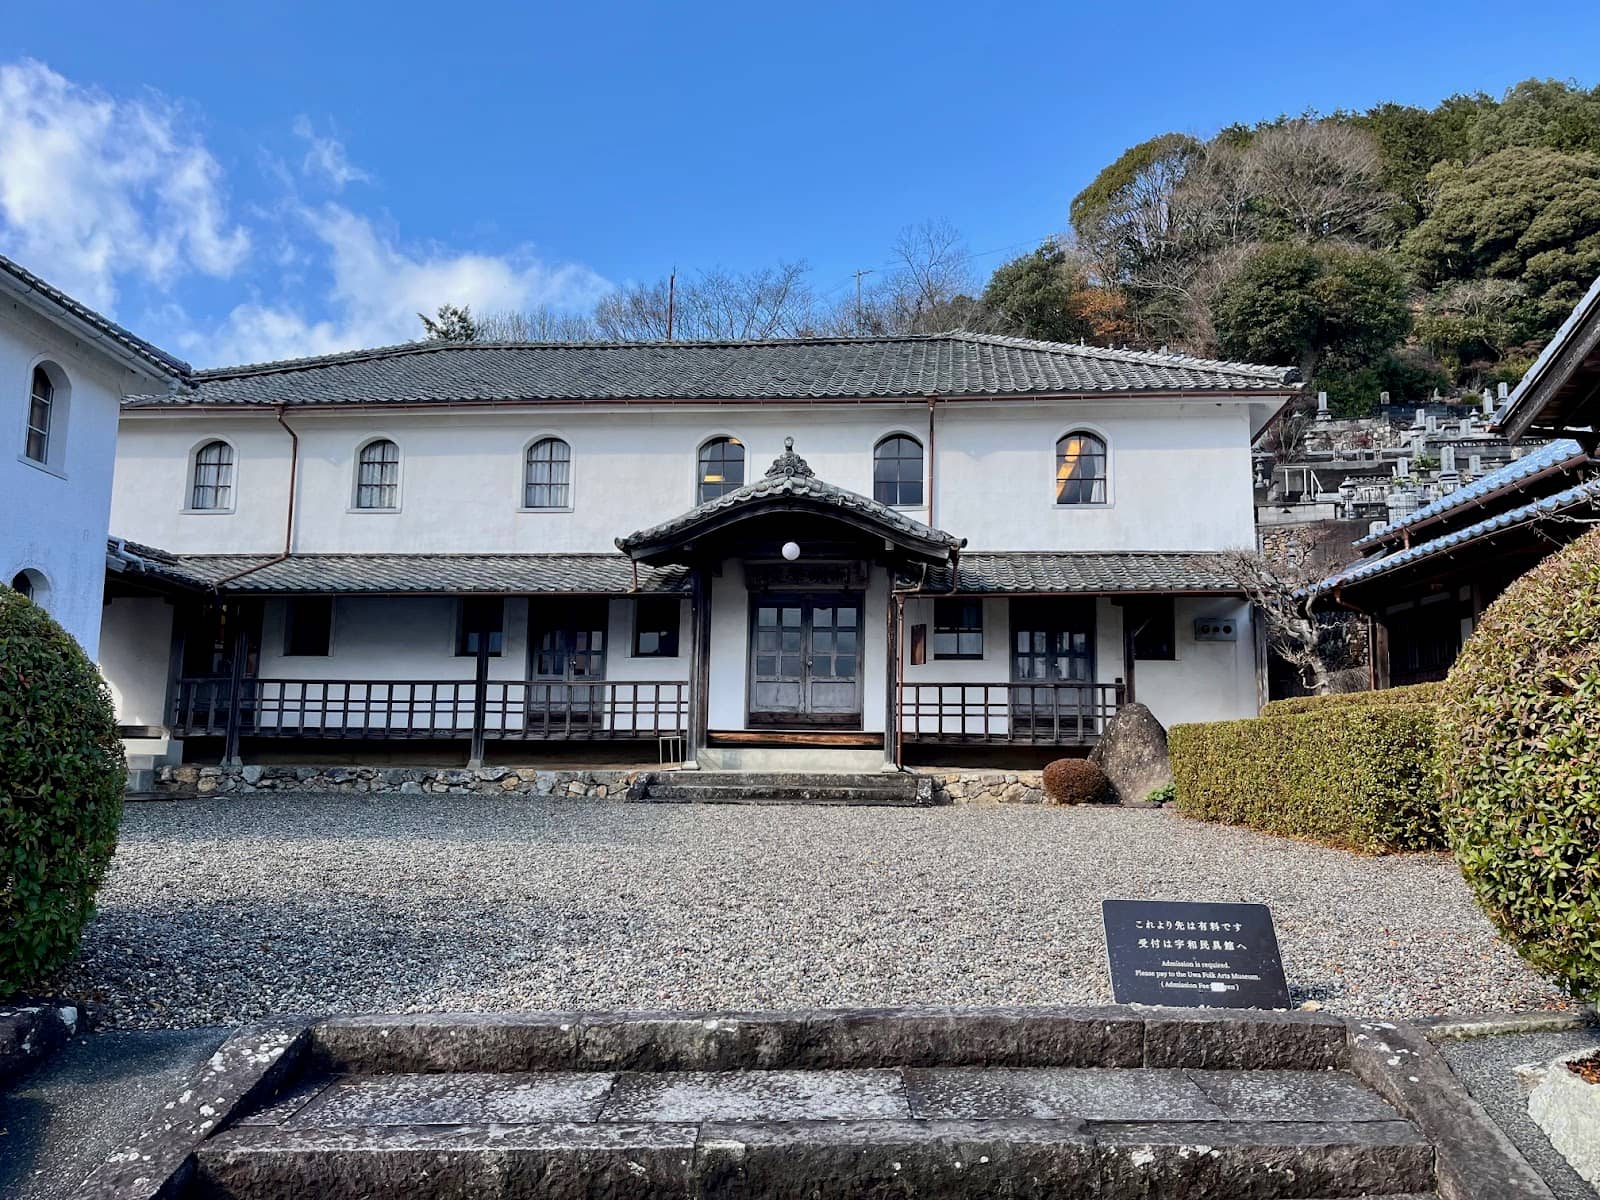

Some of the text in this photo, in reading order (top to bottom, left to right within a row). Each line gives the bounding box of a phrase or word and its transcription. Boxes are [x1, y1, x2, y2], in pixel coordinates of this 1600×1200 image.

[1135, 919, 1242, 932] これより先は有料です
[1137, 938, 1247, 950] 受付は宇和民具館へ
[1162, 960, 1194, 968] Admission
[1135, 969, 1155, 977] Please
